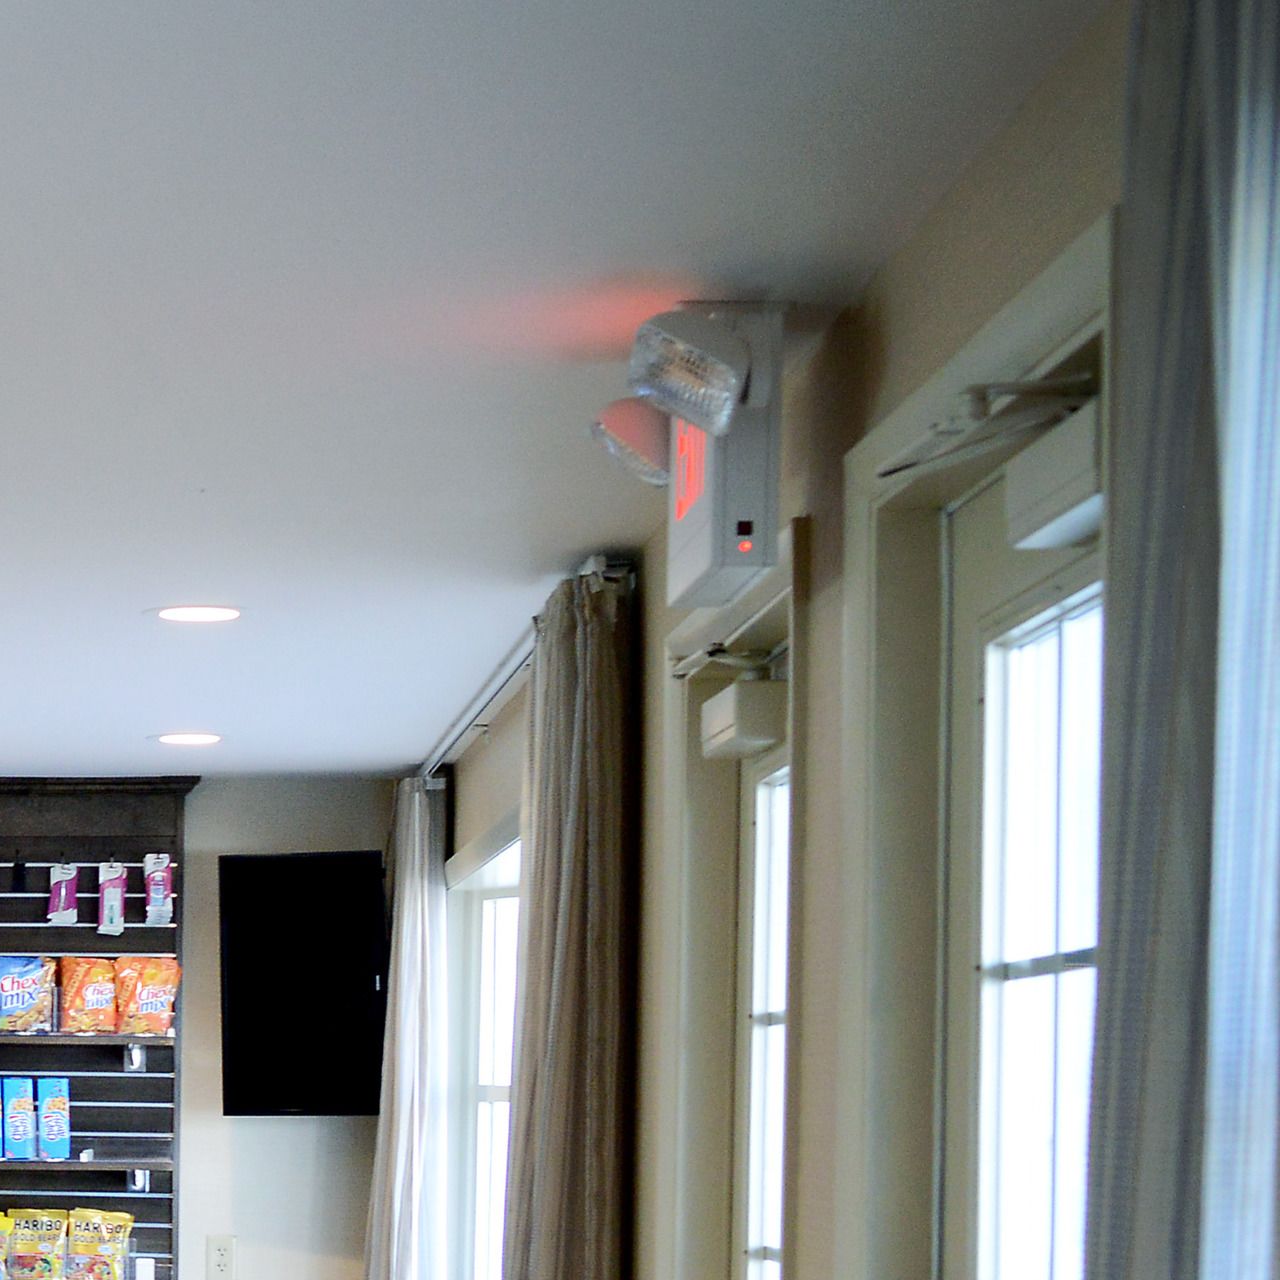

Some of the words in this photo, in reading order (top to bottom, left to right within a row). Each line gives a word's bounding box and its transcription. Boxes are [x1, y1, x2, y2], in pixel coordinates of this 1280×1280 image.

[0, 974, 39, 994] Chex
[2, 990, 38, 1009] mix
[14, 1219, 63, 1231] HARIBO
[74, 1221, 123, 1234] HARIBO
